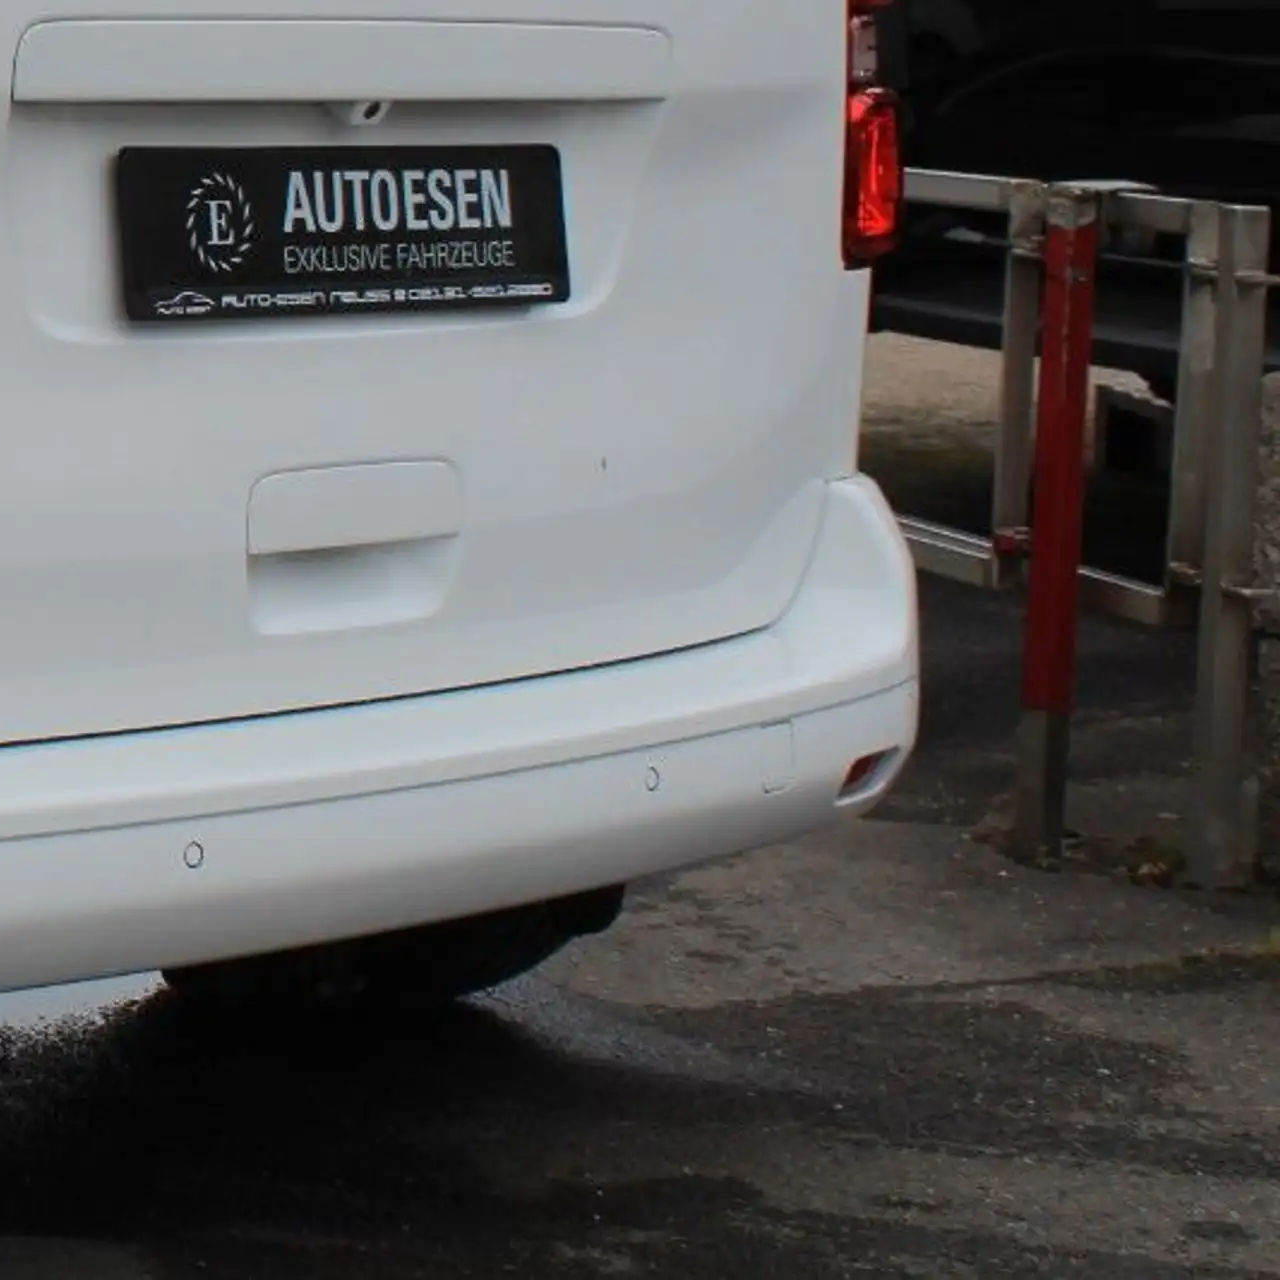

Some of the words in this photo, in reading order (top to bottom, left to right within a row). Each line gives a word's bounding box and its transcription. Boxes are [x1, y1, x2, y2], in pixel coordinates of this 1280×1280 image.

[204, 200, 235, 245] E
[283, 169, 513, 233] AUTOESEN
[283, 243, 391, 274] EXKLUSIVE
[396, 240, 516, 270] FAHRZEUGE
